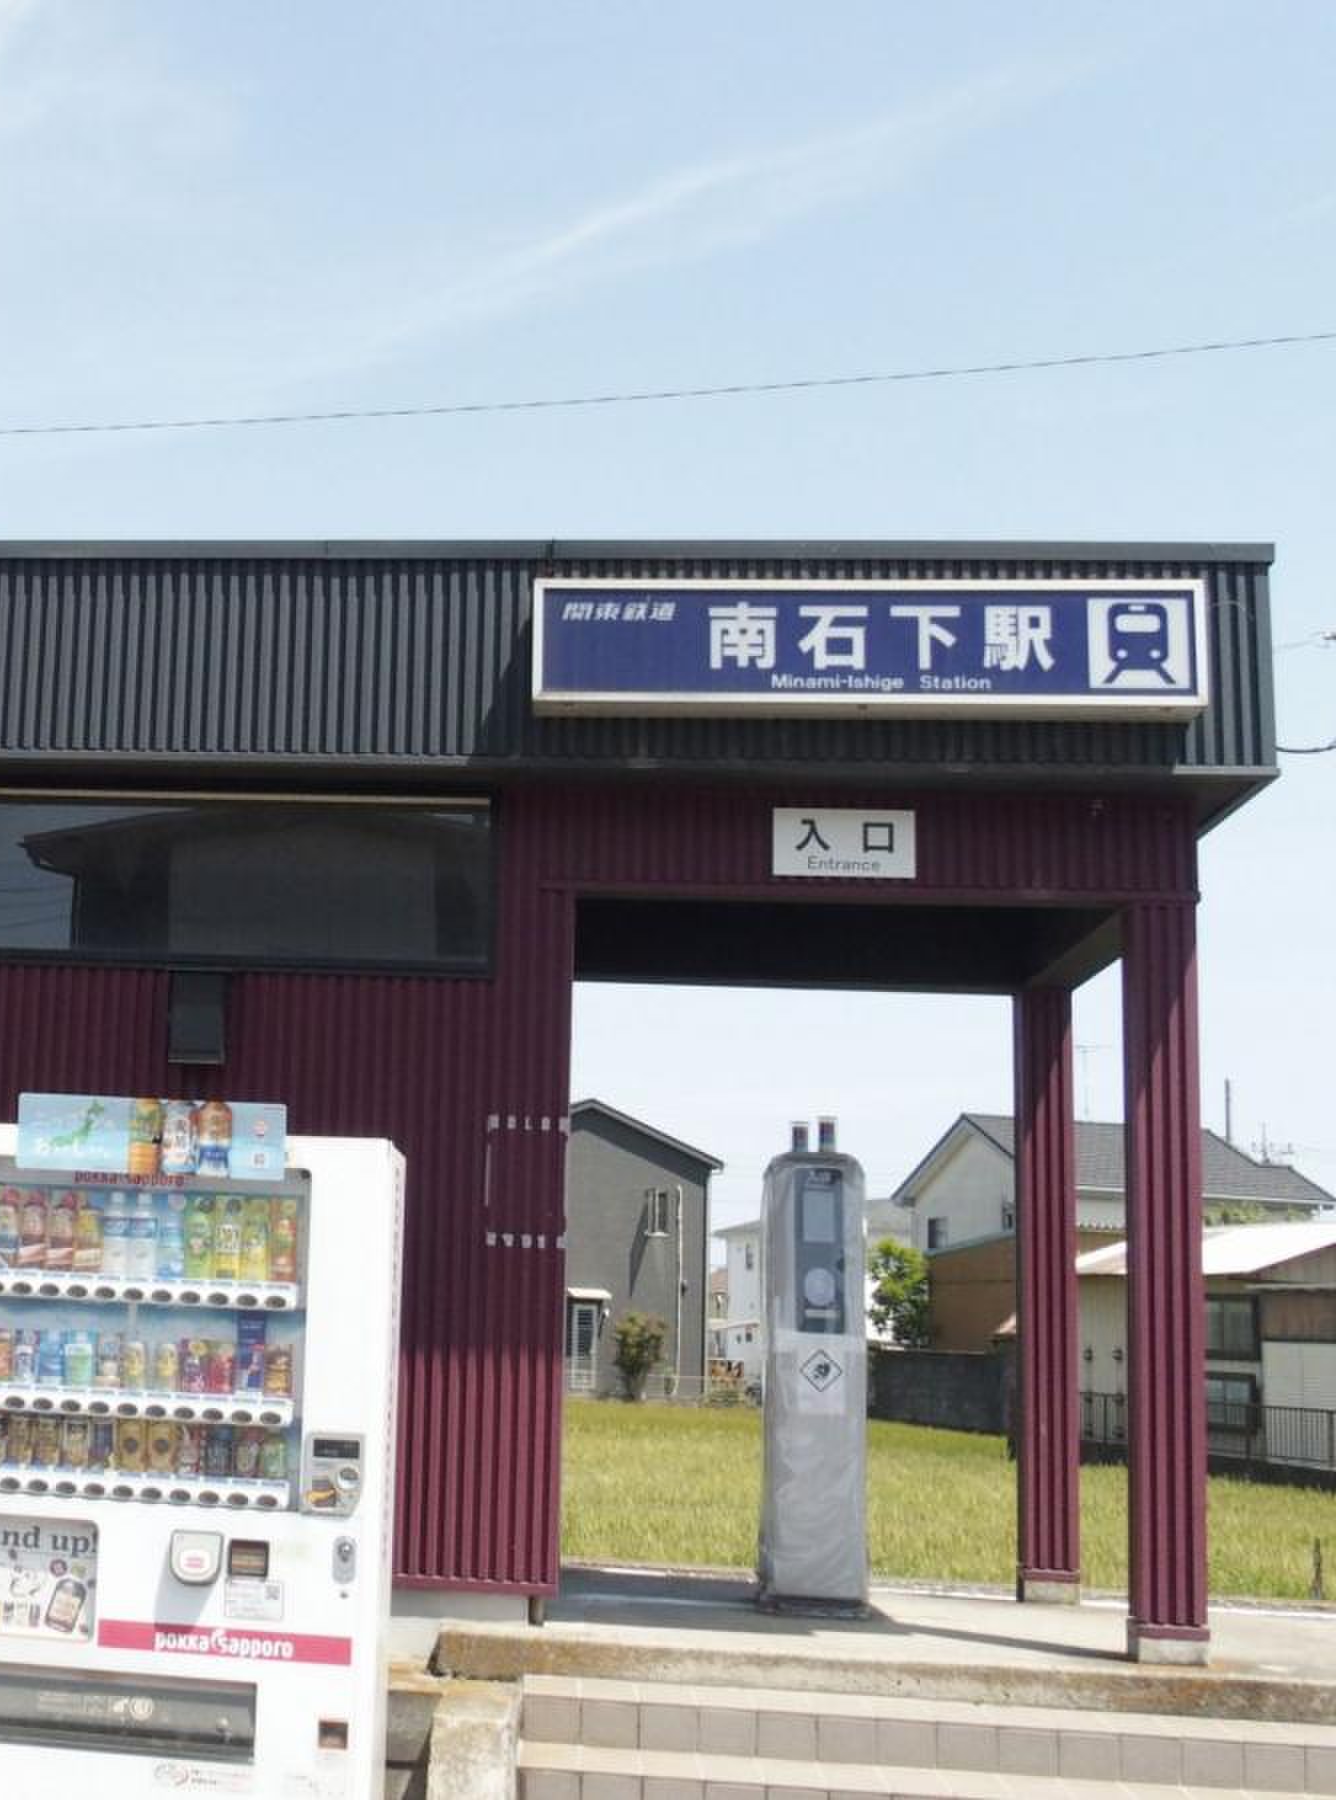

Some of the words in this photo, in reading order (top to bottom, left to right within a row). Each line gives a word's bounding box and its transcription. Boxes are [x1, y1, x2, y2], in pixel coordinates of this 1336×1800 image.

[562, 601, 676, 622] 関東鉄道
[708, 601, 1056, 671] 南石下駅
[771, 674, 904, 692] Minami-Ishige
[920, 674, 992, 690] Station
[795, 818, 895, 853] 入口
[807, 855, 881, 872] Entrance
